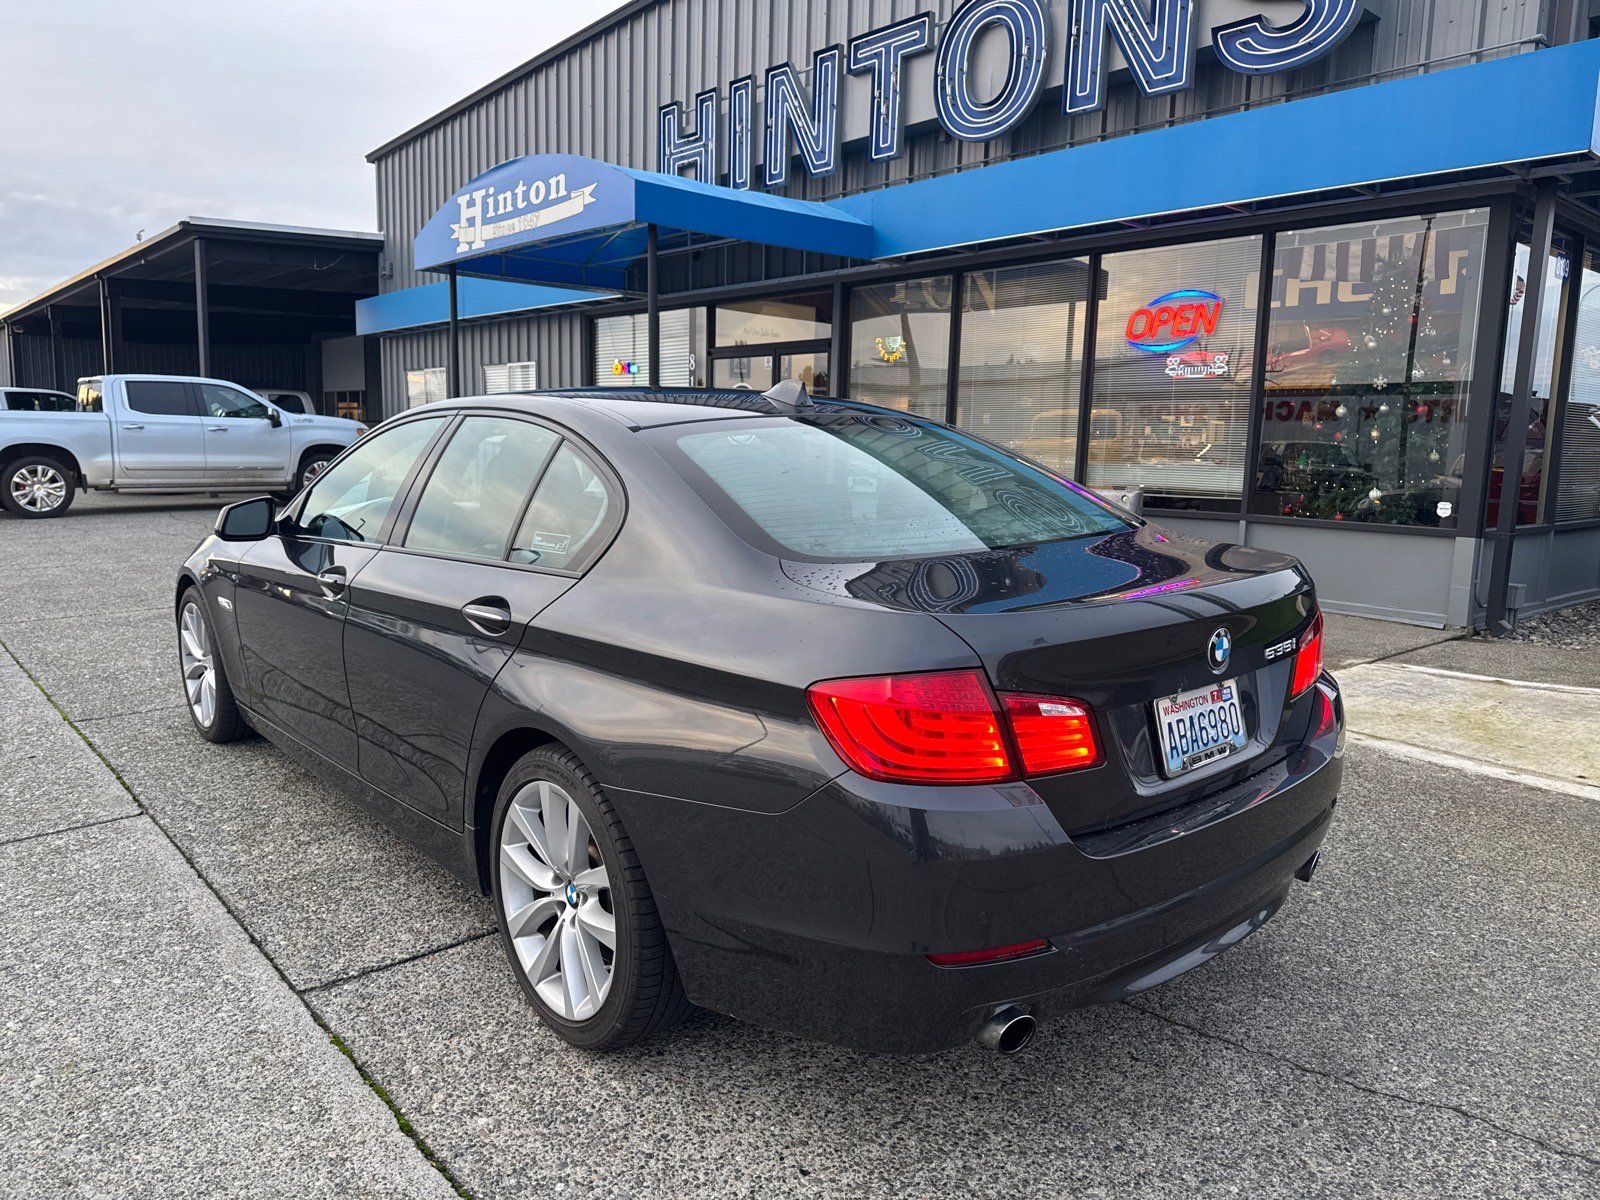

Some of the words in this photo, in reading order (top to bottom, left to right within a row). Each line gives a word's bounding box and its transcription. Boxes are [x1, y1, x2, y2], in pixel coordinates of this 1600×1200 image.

[456, 173, 567, 253] Hinton
[1125, 301, 1222, 341] OPEN
[1265, 638, 1296, 660] 535i
[1163, 694, 1208, 716] WASHINGTON
[1167, 702, 1240, 759] ABA6980
[1192, 745, 1227, 764] BMW
